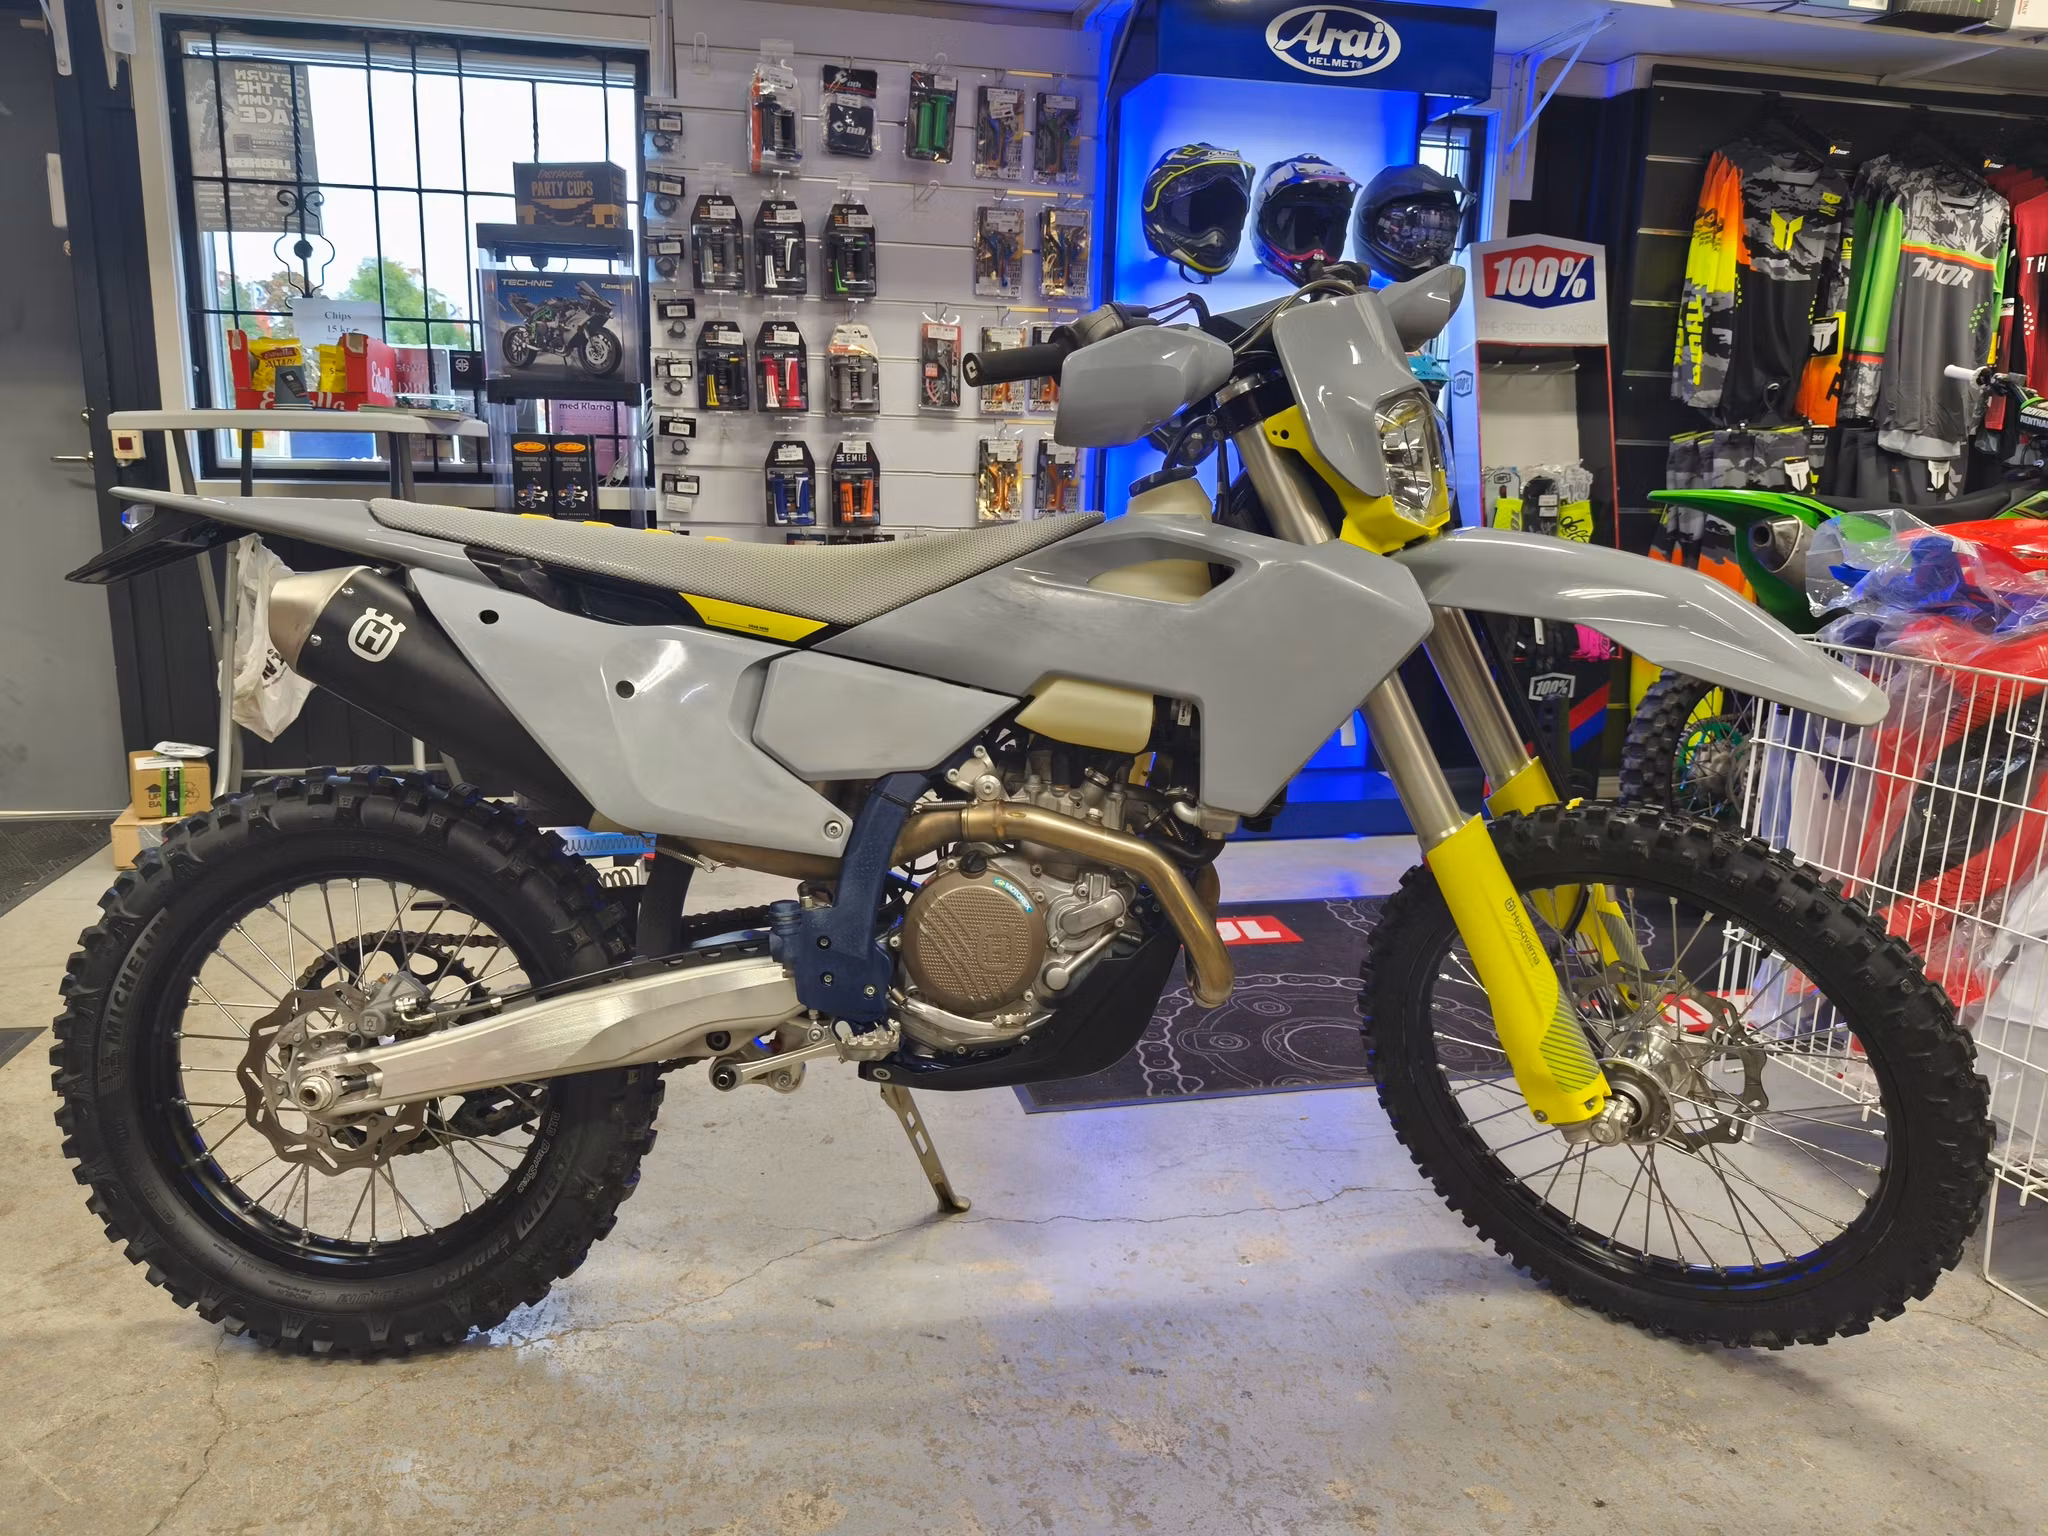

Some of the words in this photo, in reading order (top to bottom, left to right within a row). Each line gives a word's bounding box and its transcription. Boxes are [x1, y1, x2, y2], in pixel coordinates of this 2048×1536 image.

[1274, 12, 1386, 59] Arai
[531, 181, 564, 197] PARTY
[567, 180, 594, 197] CUPS
[1493, 256, 1588, 299] 100%
[1912, 257, 1974, 289] THOR
[501, 278, 554, 288] TECHNIC
[324, 311, 352, 321] Chips
[327, 325, 338, 333] 15
[559, 402, 580, 410] med
[581, 402, 614, 411] Klarna.
[846, 453, 868, 462] EMIG
[1536, 680, 1570, 696] 100%
[1511, 911, 1540, 966] Husqvarna
